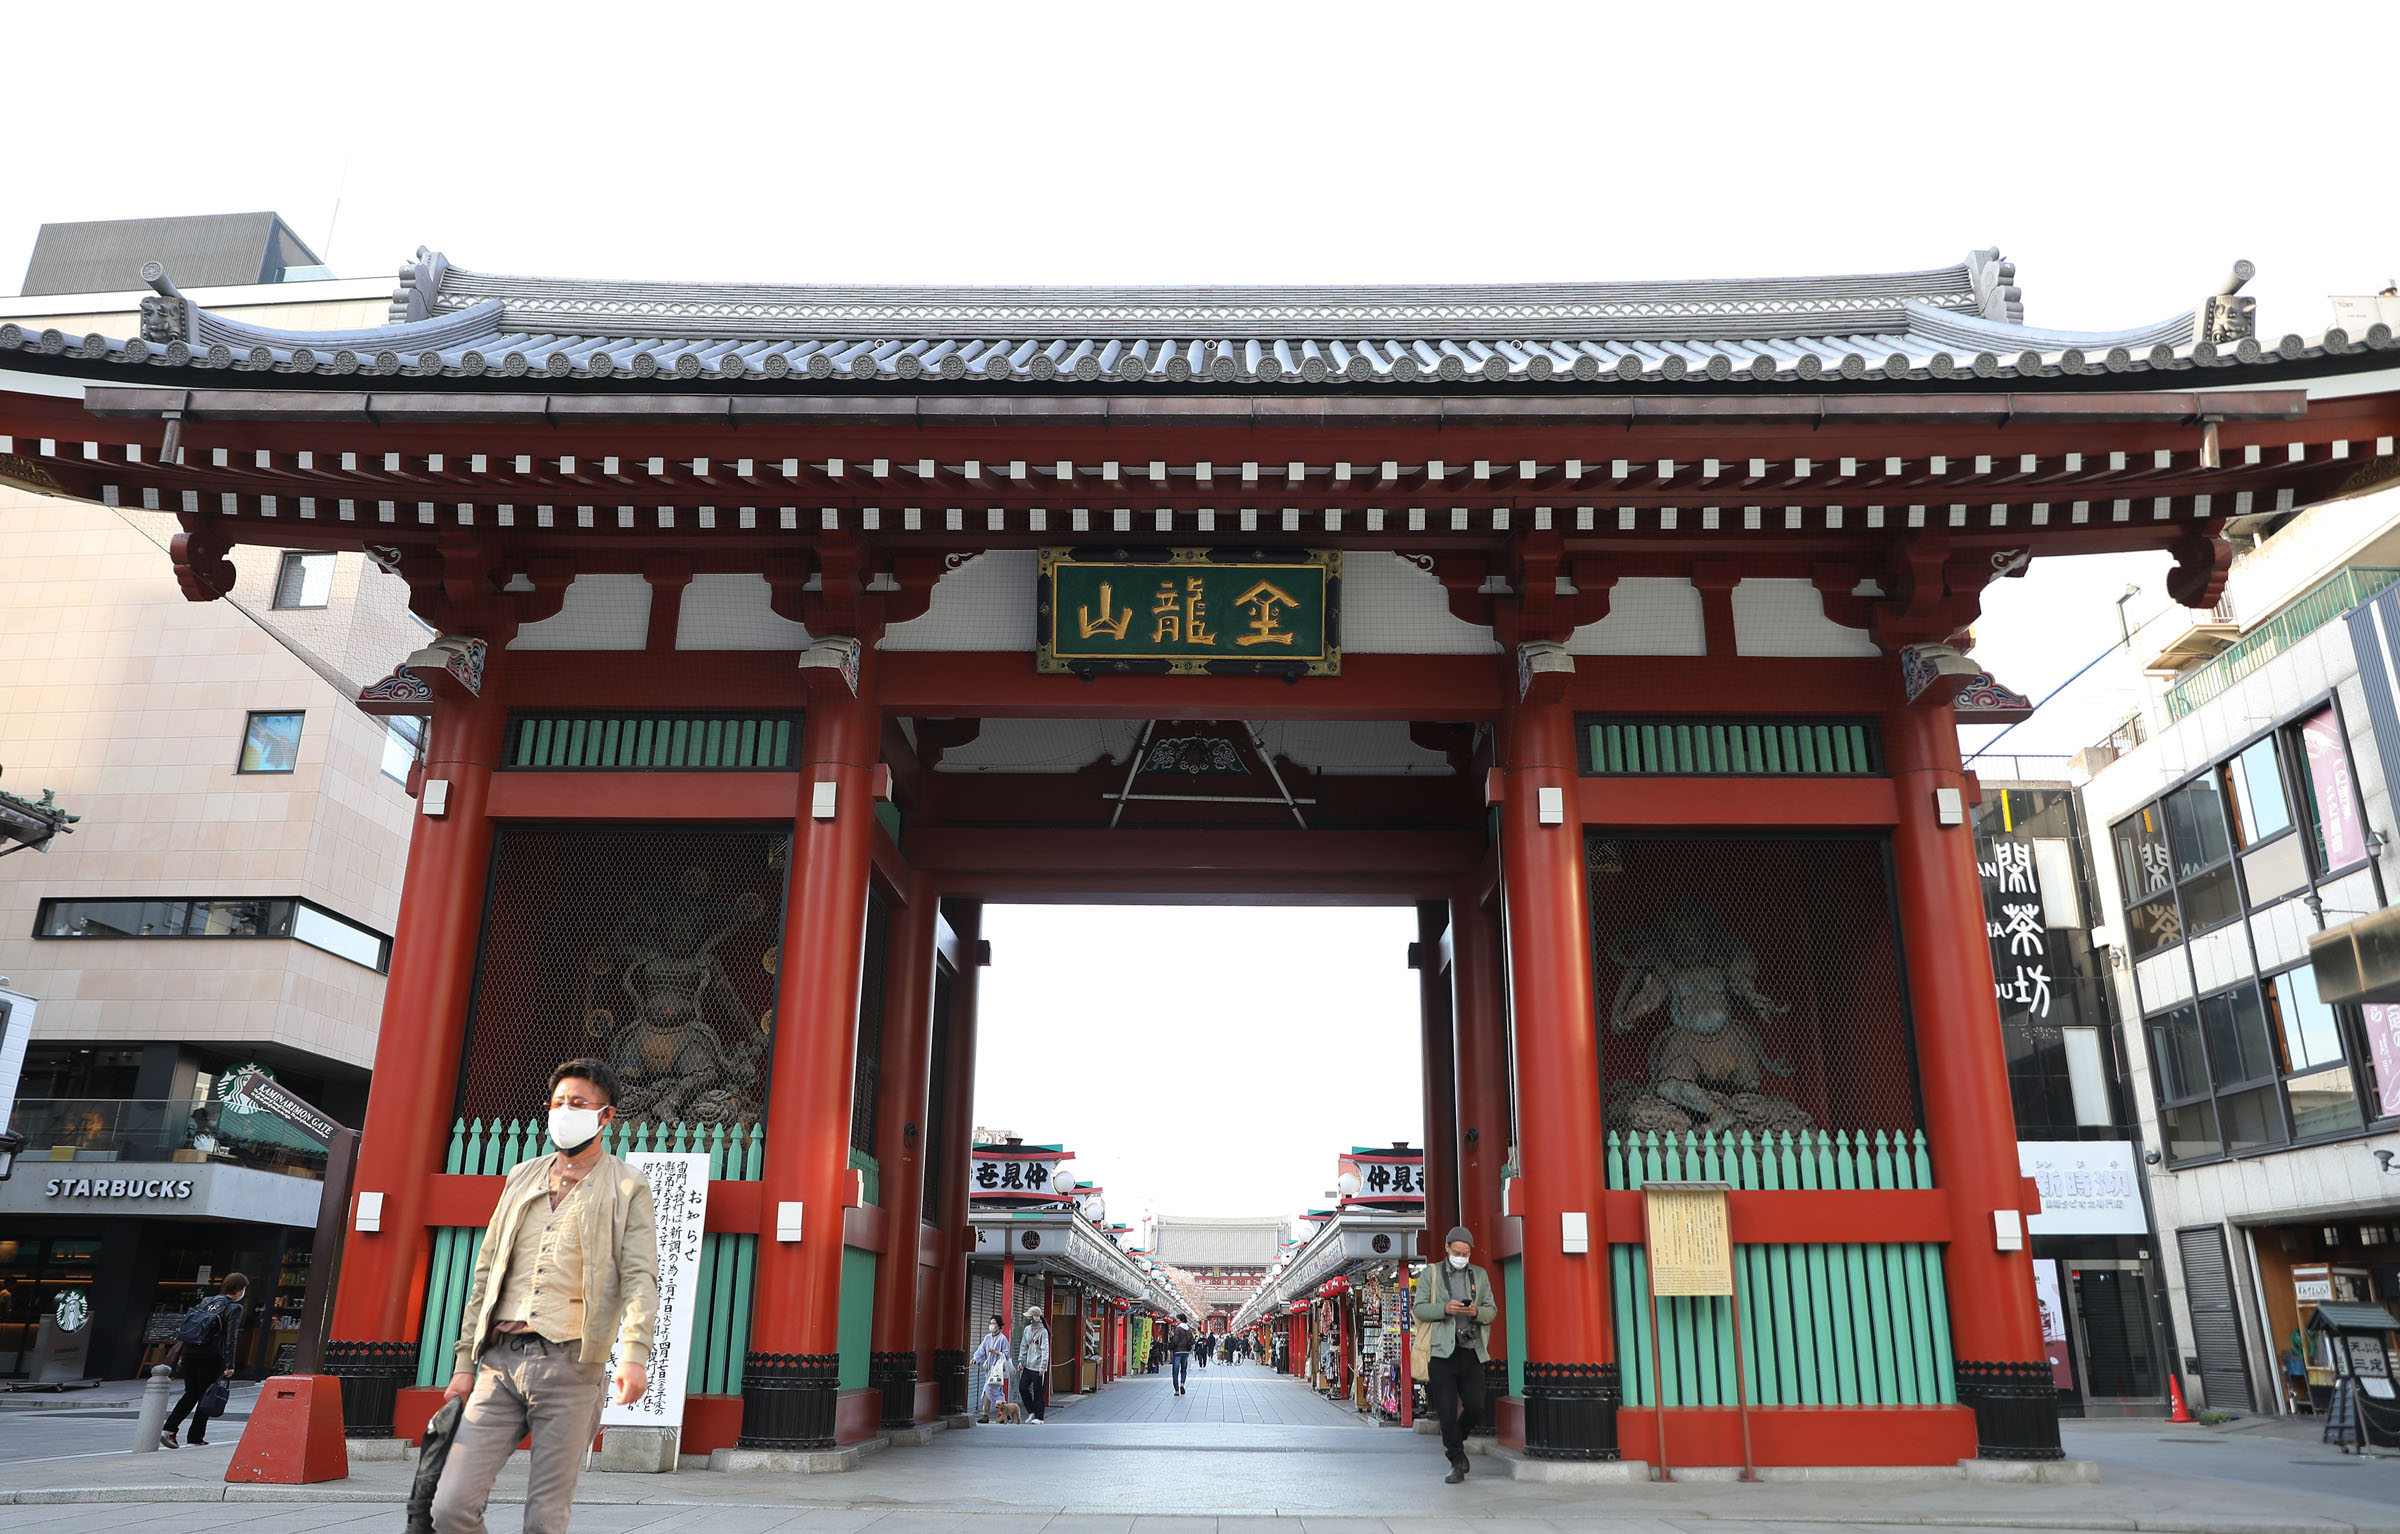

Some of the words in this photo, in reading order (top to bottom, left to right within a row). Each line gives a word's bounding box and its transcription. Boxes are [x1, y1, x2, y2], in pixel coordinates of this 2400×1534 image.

[258, 1083, 314, 1122] KAMINARIMON
[311, 1116, 334, 1135] GATE
[45, 1178, 193, 1198] STARBUCKS
[684, 1190, 702, 1261] お知らせ
[2349, 1341, 2382, 1354] 天ぷら
